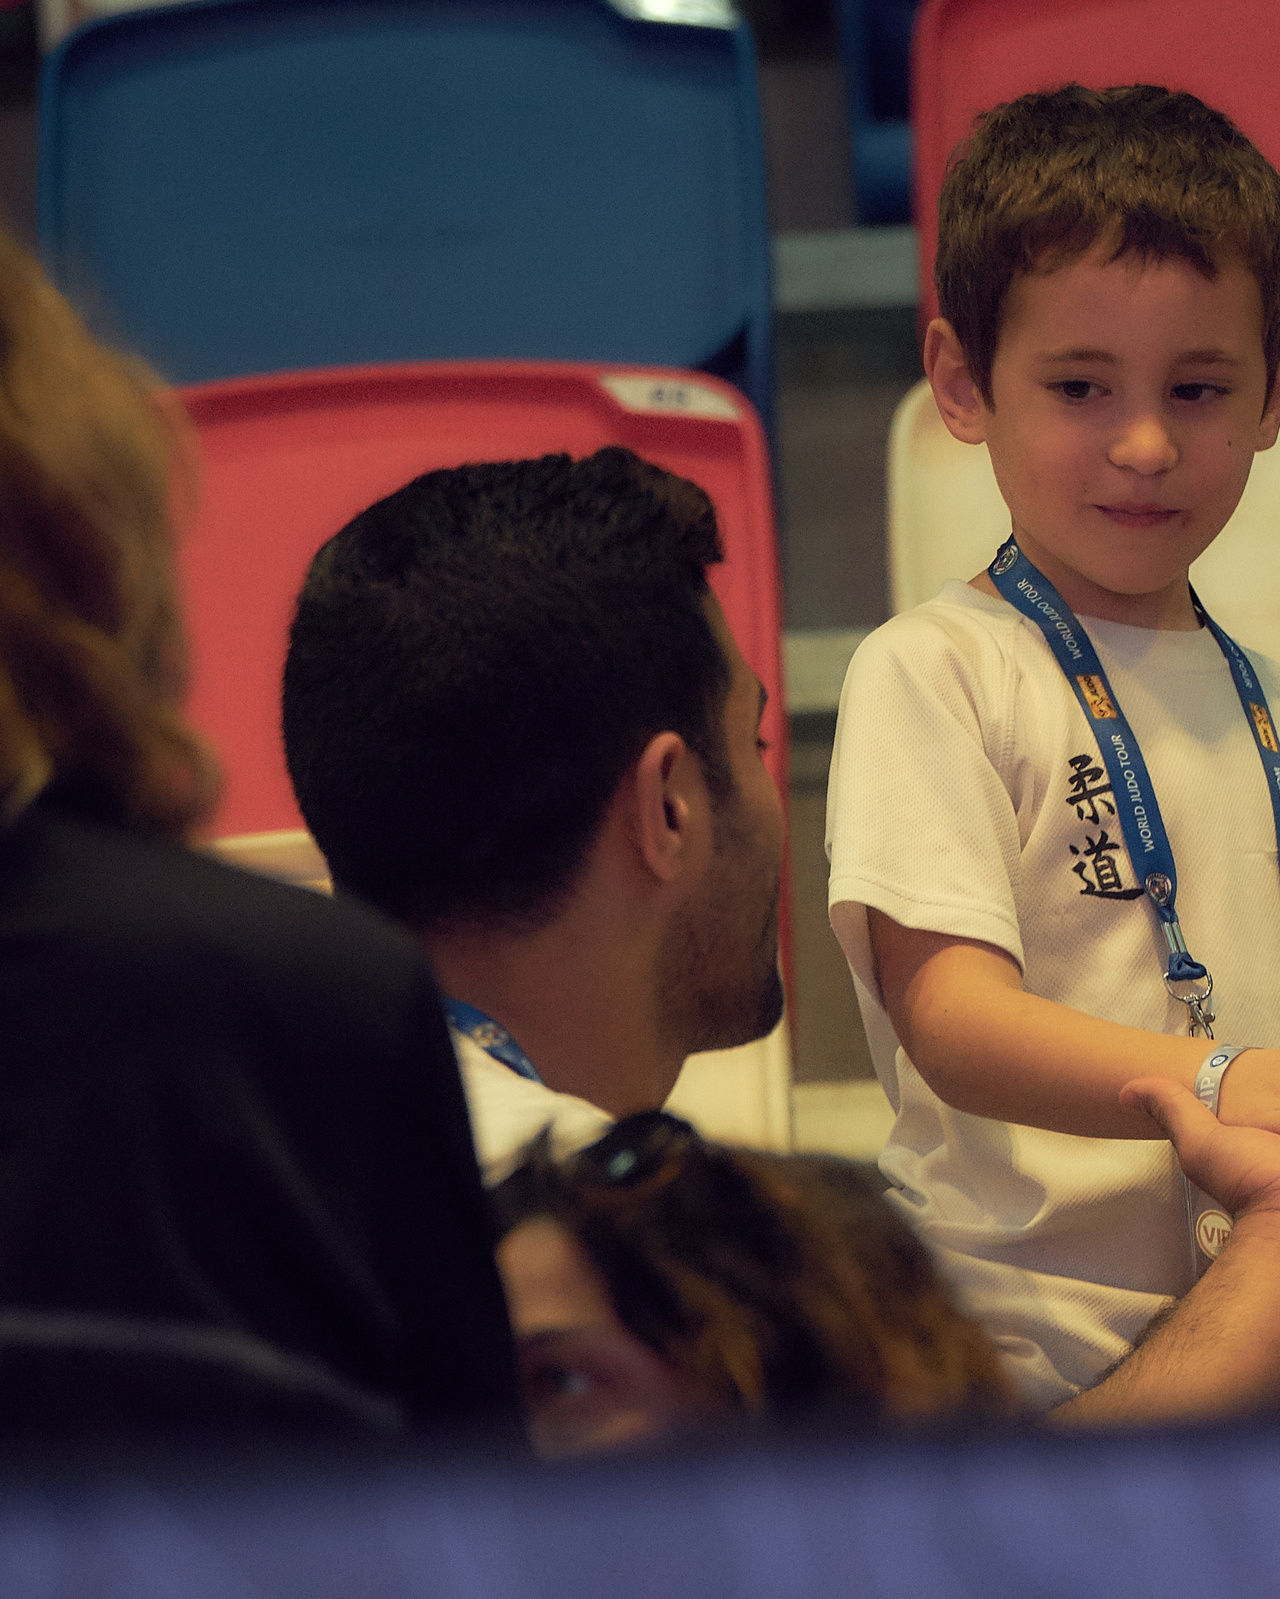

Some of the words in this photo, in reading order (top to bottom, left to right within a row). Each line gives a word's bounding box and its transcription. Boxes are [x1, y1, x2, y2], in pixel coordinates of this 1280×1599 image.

[1017, 578, 1042, 604] TOUR
[1037, 601, 1061, 621] JUDO
[1056, 621, 1083, 660] WORLD
[1111, 734, 1131, 768] TOUR
[1124, 769, 1142, 803] JUDO
[1066, 754, 1145, 900] 柔道
[1134, 805, 1155, 852] WORLD
